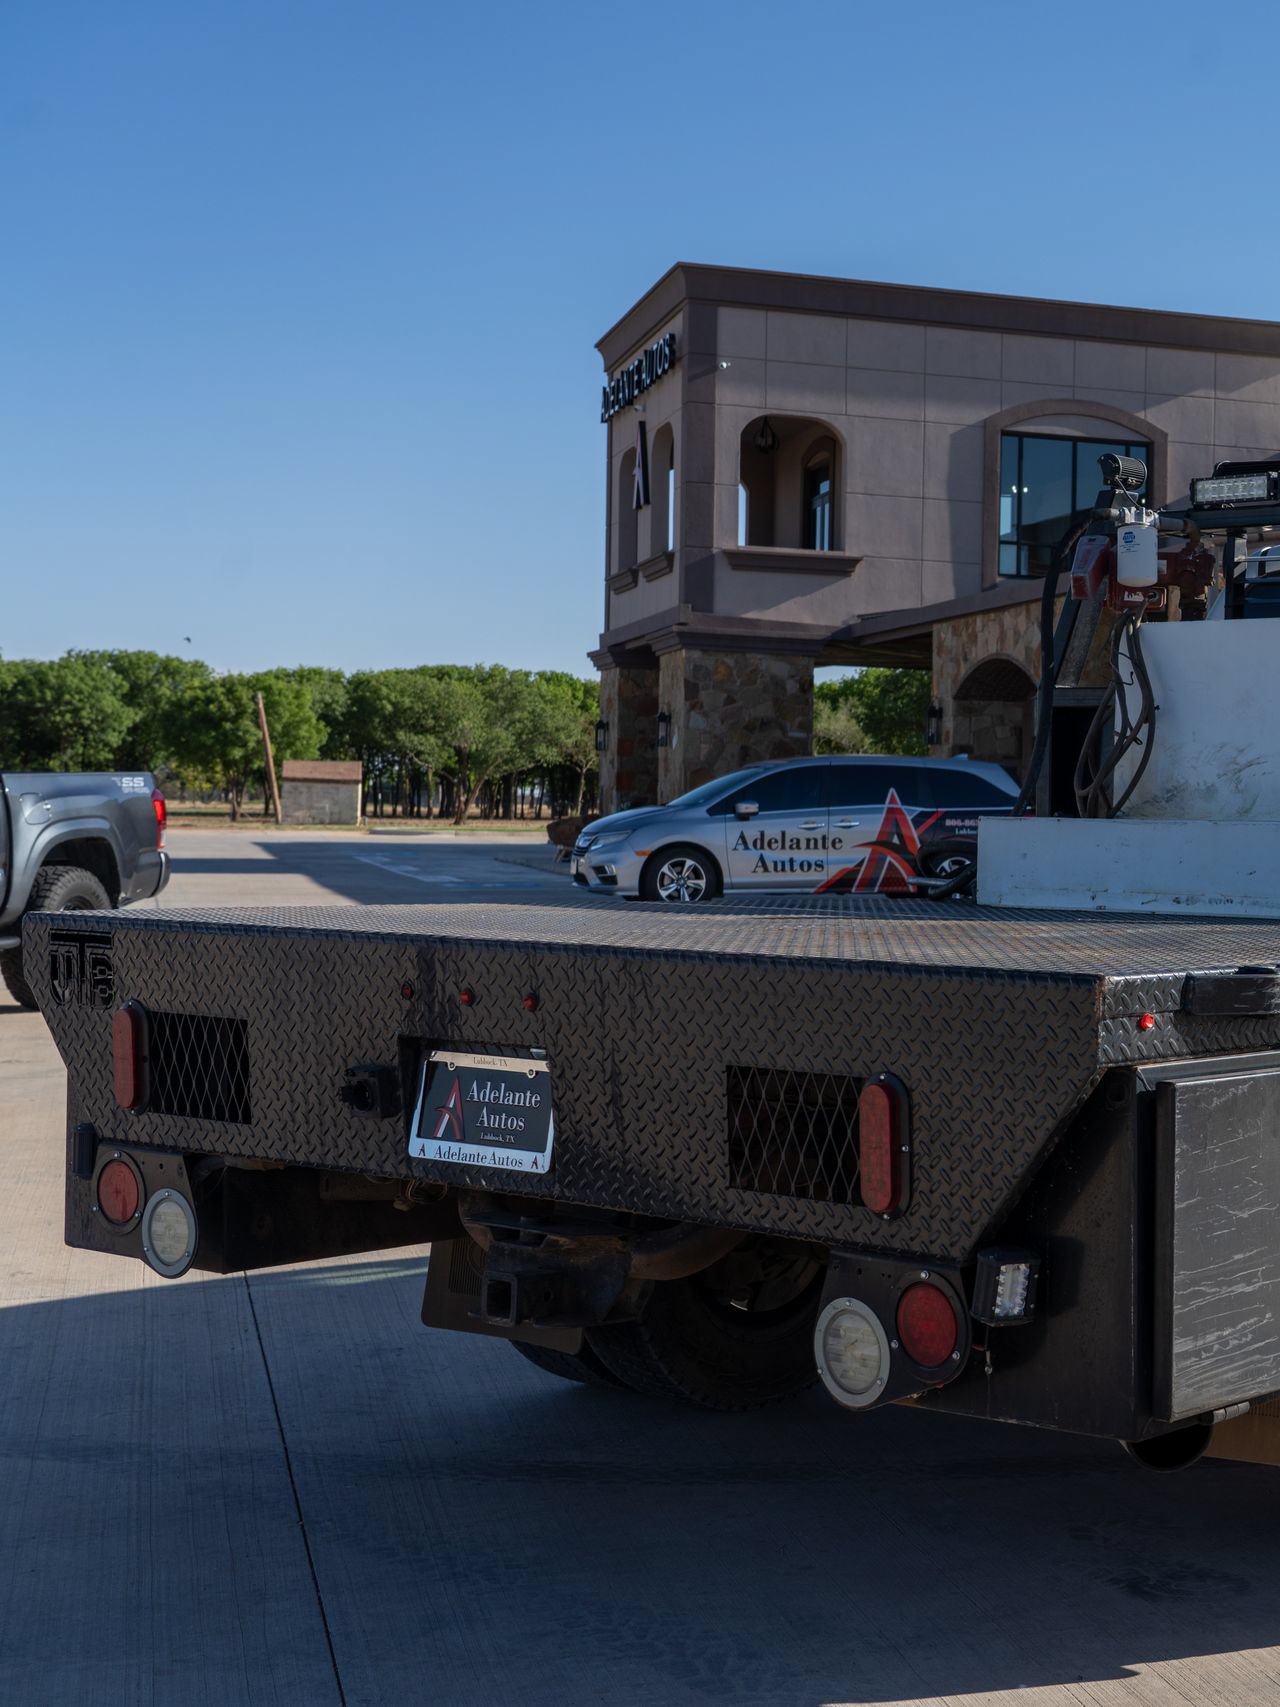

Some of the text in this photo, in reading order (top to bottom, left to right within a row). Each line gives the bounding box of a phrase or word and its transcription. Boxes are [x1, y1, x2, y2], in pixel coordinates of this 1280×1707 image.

[600, 332, 675, 423] ADELANTE AUTOS
[732, 829, 844, 851] Adelante
[751, 852, 825, 874] Autos
[466, 1079, 541, 1108] Adelante
[475, 1105, 526, 1132] Autos
[504, 1134, 516, 1143] TX
[433, 1145, 524, 1169] Adelante Autos
